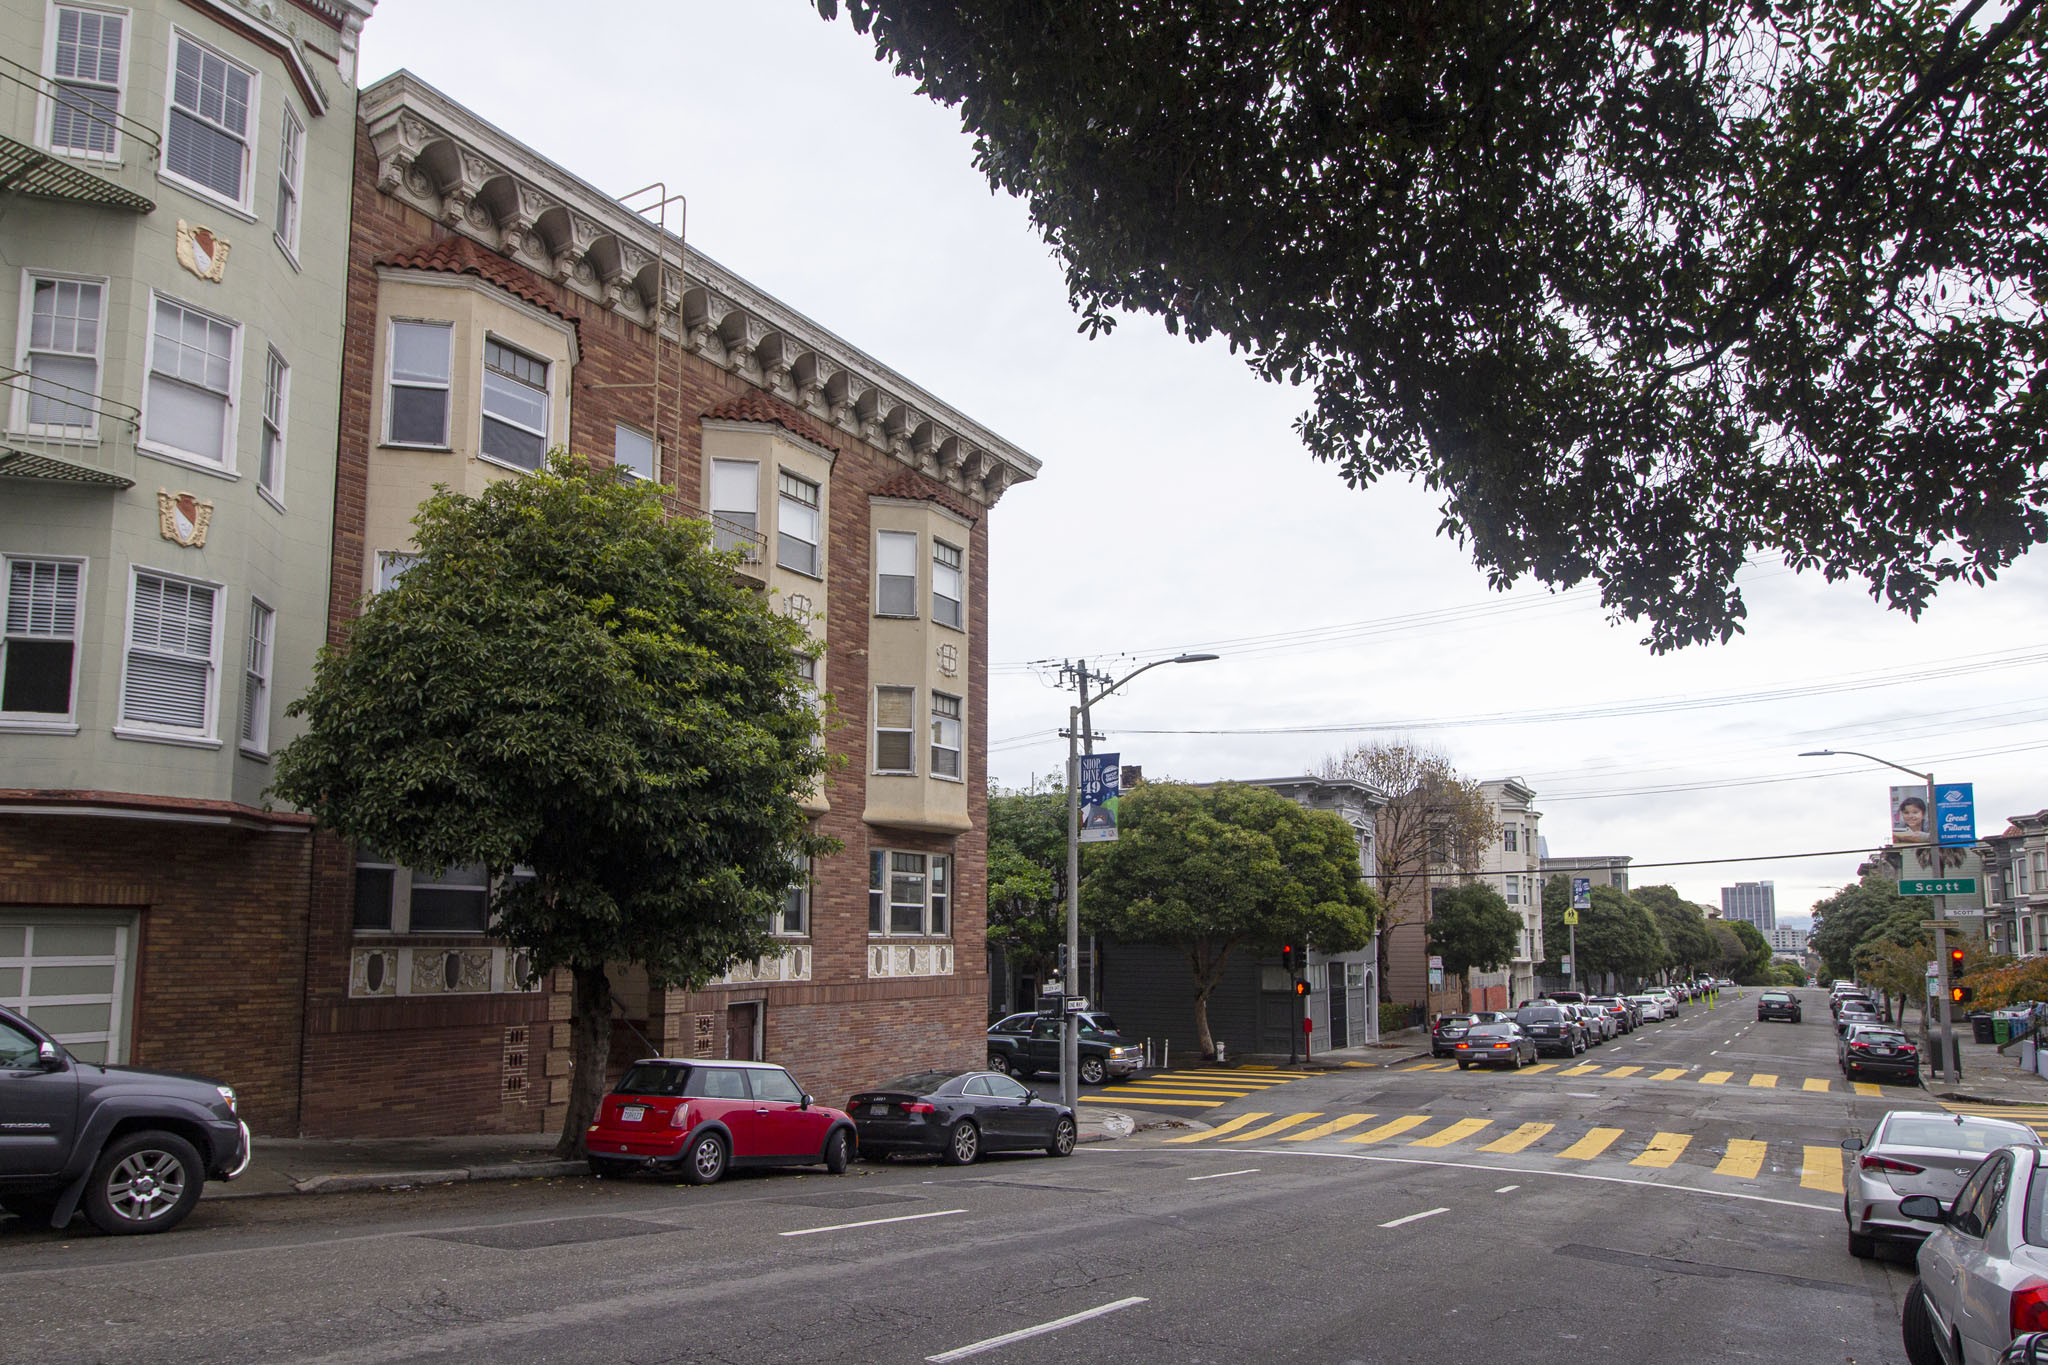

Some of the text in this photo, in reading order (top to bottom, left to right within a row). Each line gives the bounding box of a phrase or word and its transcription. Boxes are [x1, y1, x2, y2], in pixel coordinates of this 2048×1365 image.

[1083, 758, 1101, 770] SHOP
[1083, 769, 1101, 782] DINE
[1083, 780, 1101, 794] 49
[1945, 813, 1968, 823] Great
[1942, 822, 1972, 833] Futures
[1915, 882, 1960, 892] Scott
